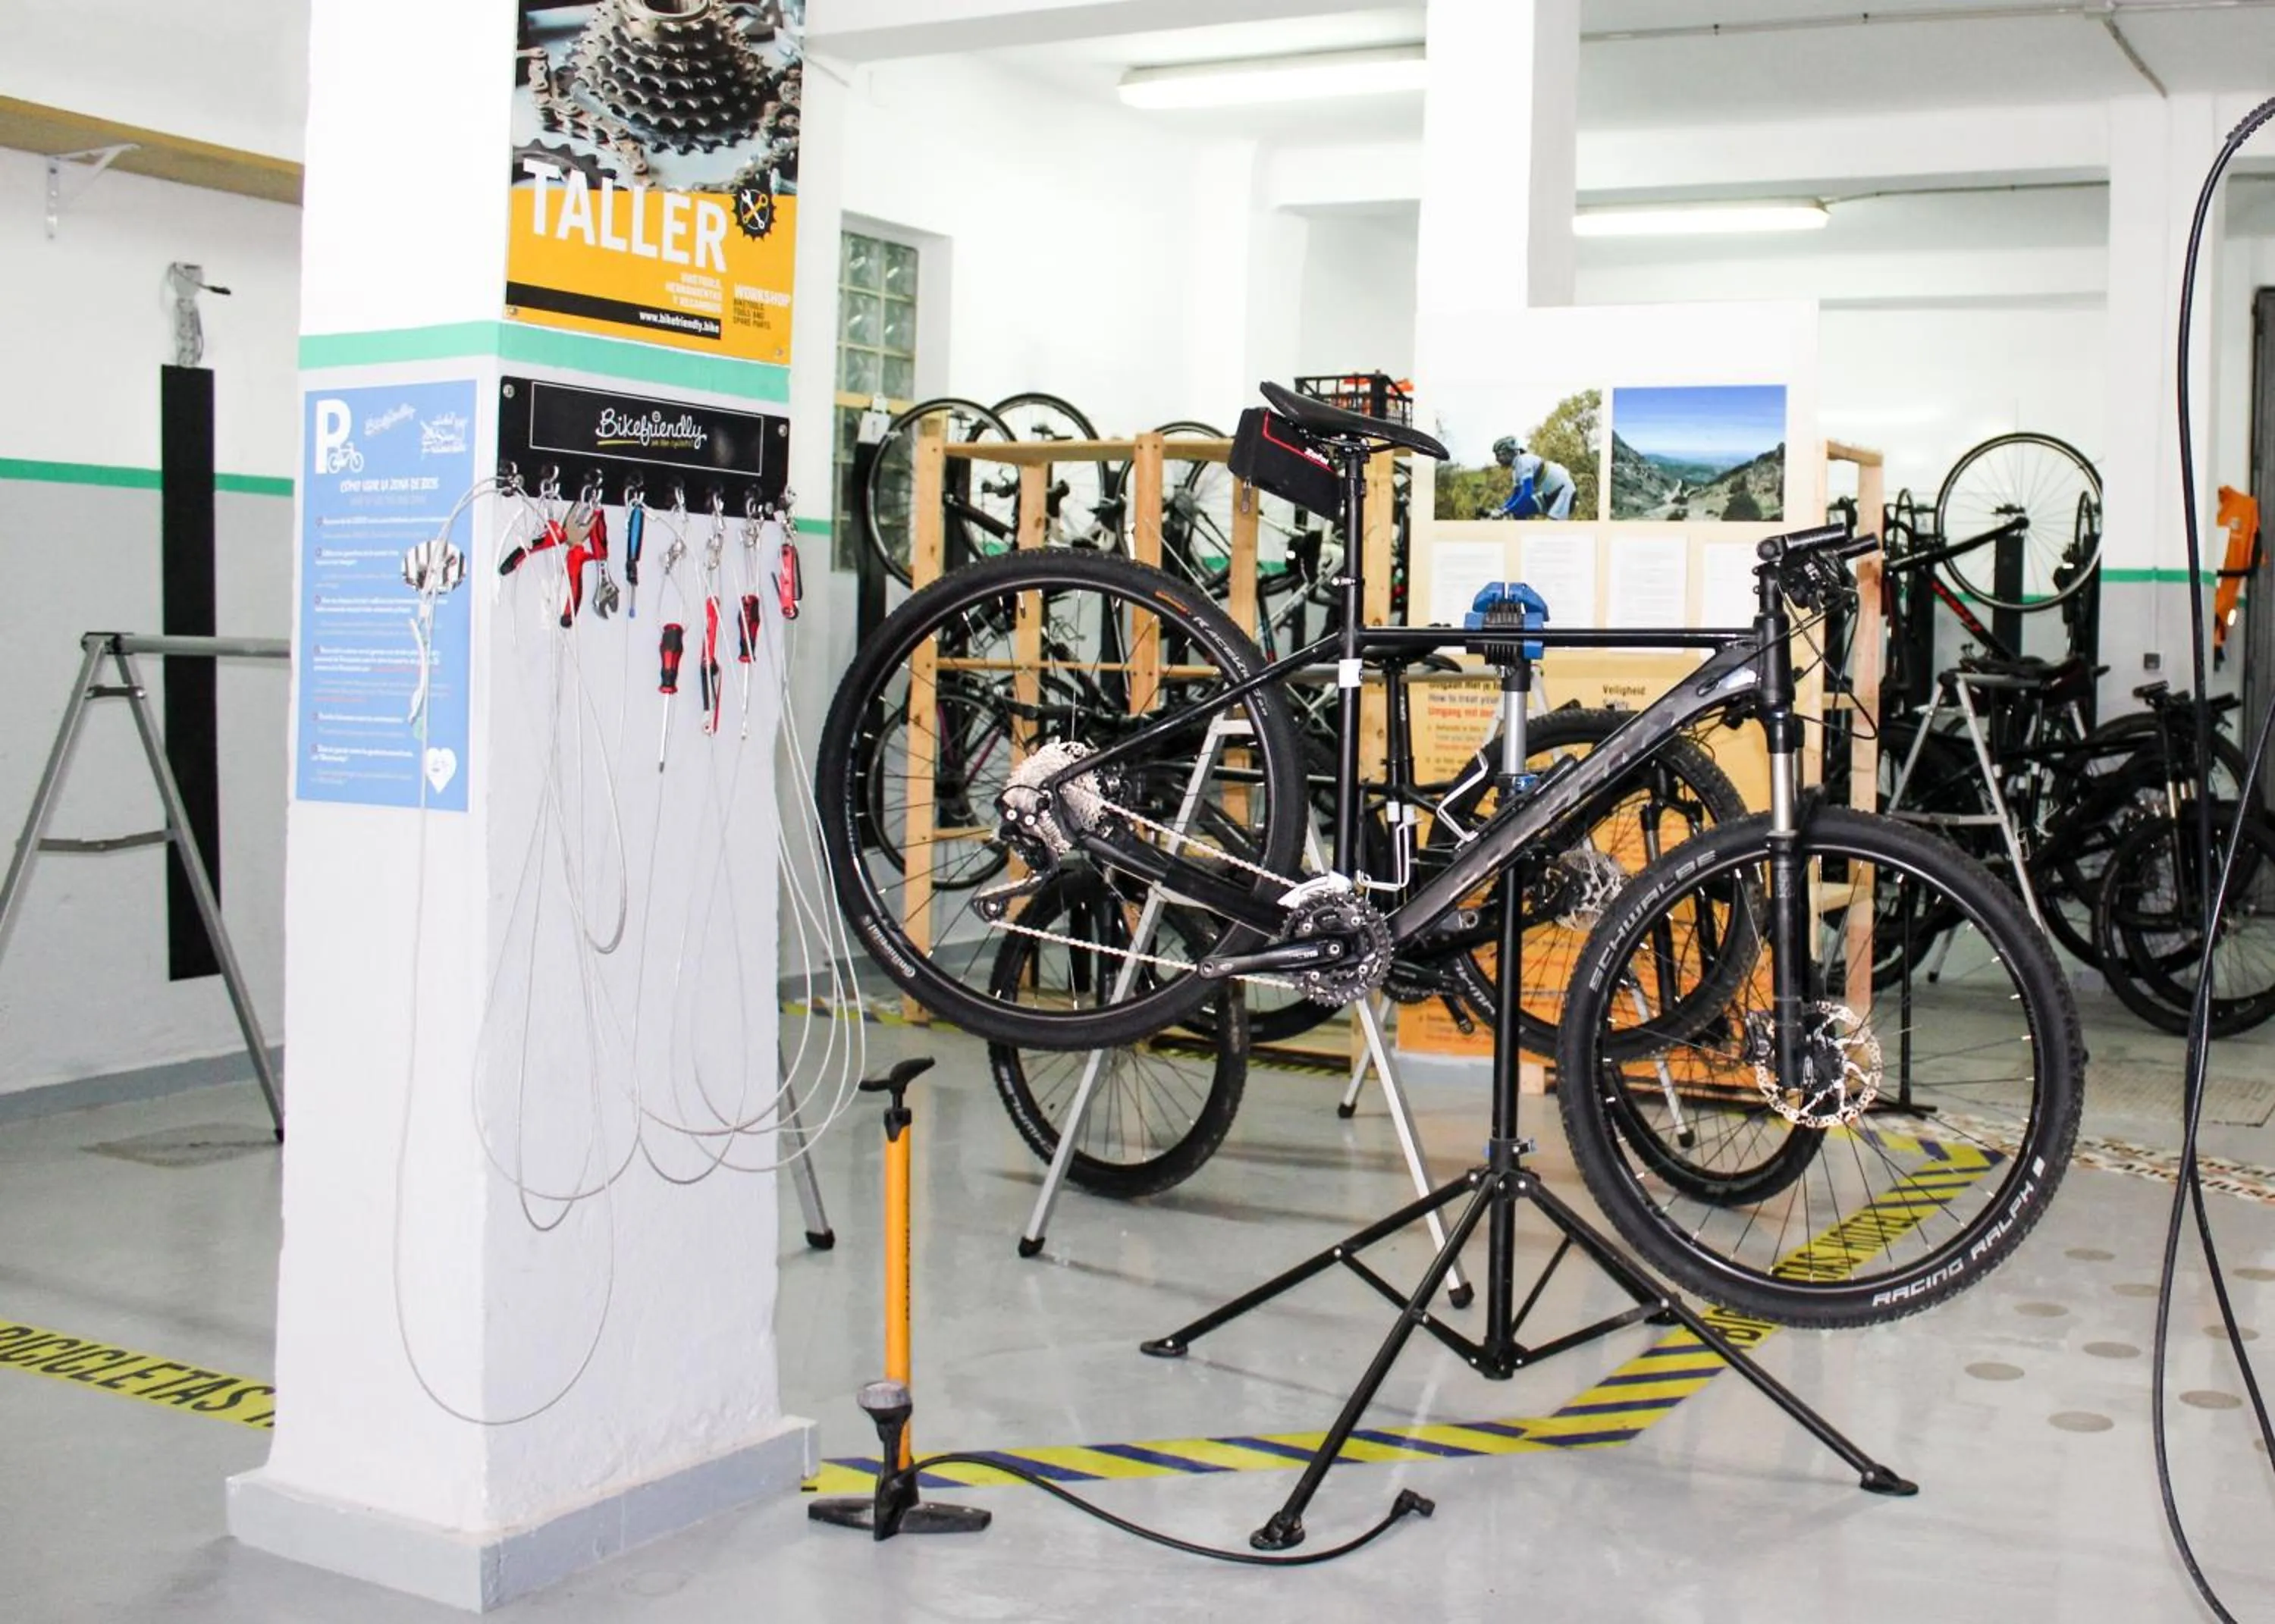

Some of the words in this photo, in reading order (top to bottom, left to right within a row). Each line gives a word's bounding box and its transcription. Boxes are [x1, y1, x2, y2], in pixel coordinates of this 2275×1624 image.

[523, 158, 727, 272] TALLER
[595, 407, 707, 450] Bikefriendly
[1602, 685, 1646, 697] Veiligheid
[1589, 850, 1717, 992] SCHWALBE
[1872, 1257, 1965, 1307] RACING
[1972, 1180, 2034, 1261] RALPH
